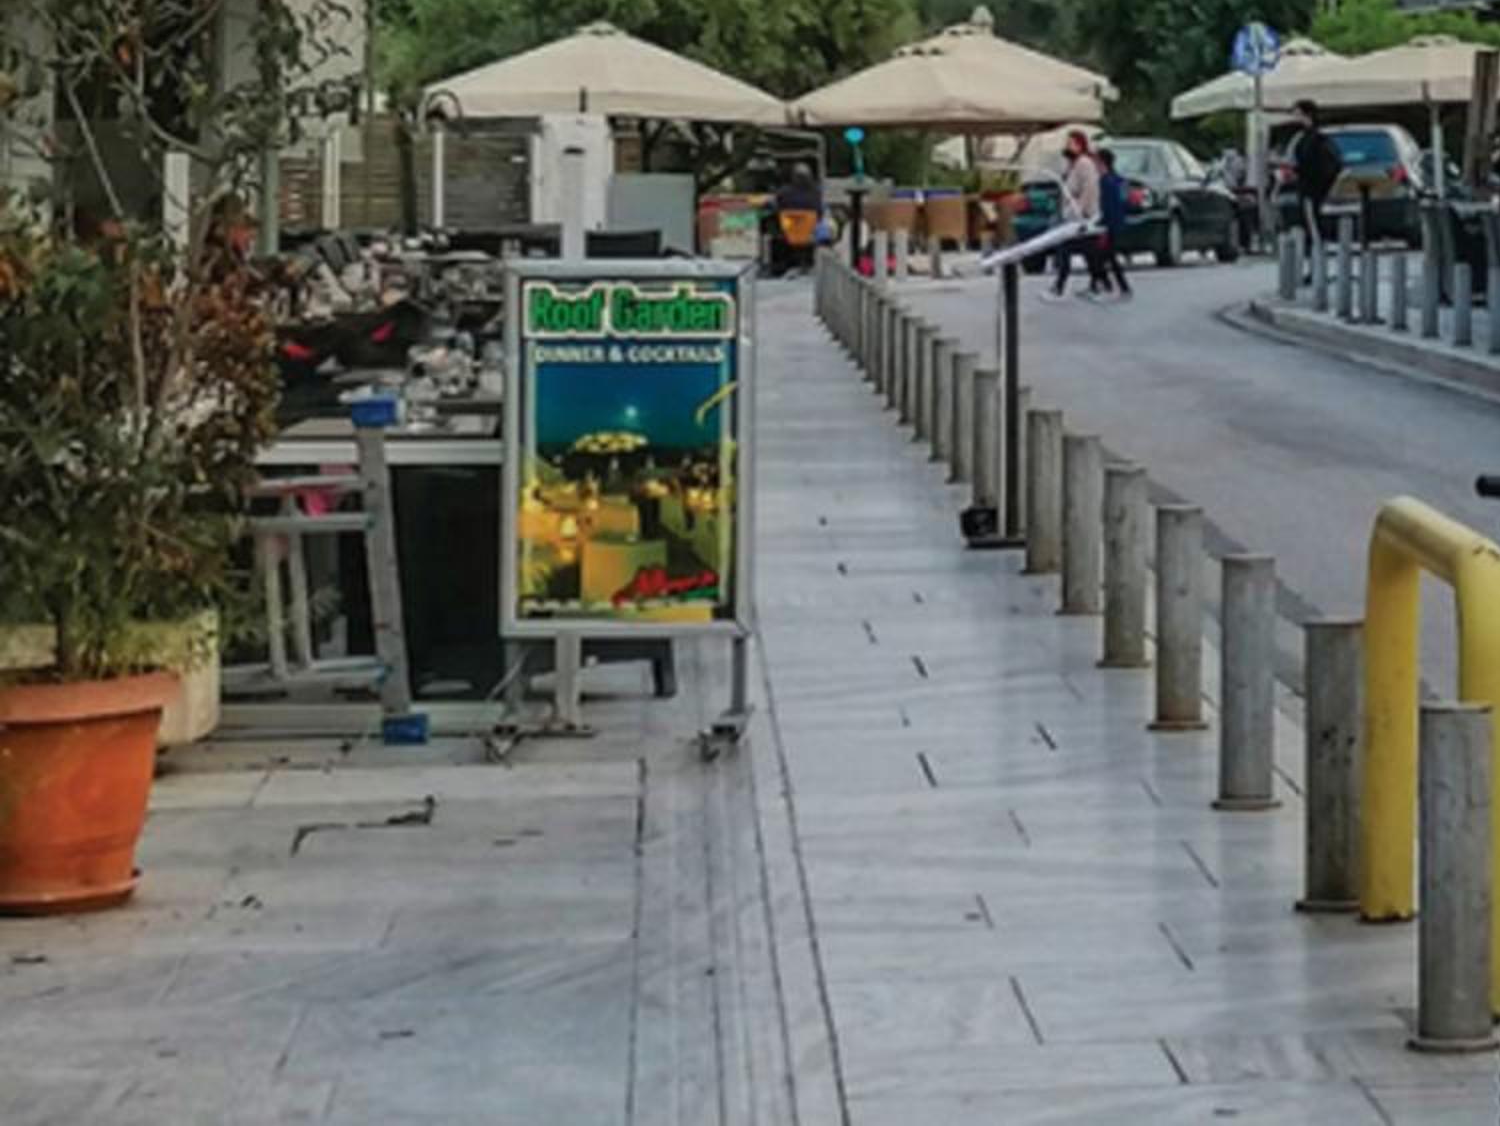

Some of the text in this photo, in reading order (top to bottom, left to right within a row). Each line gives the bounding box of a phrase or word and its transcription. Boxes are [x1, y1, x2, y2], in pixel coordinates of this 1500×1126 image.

[528, 285, 728, 331] Roof Garden
[533, 345, 724, 364] DINNER & COCKTAILS
